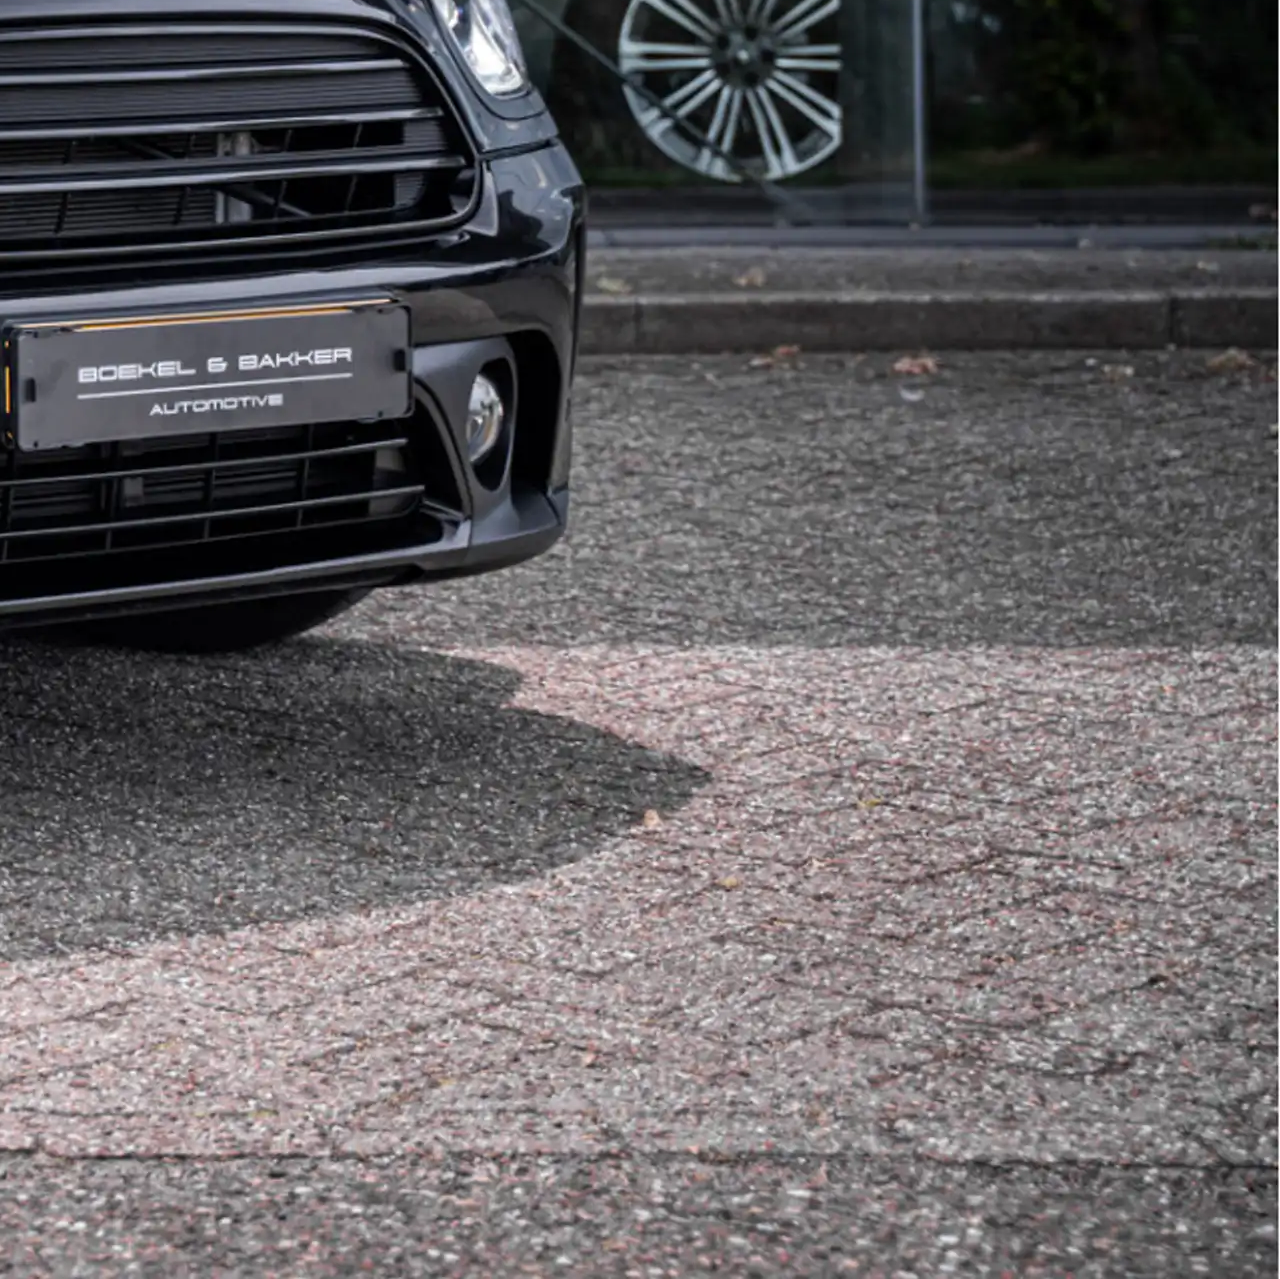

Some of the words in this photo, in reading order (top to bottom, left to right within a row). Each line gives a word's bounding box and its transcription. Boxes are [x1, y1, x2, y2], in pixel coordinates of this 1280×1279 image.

[78, 360, 197, 384] BOEKEL
[206, 356, 229, 374] &
[237, 347, 353, 372] BAKKER
[149, 393, 284, 417] AUTOMOTIVE
